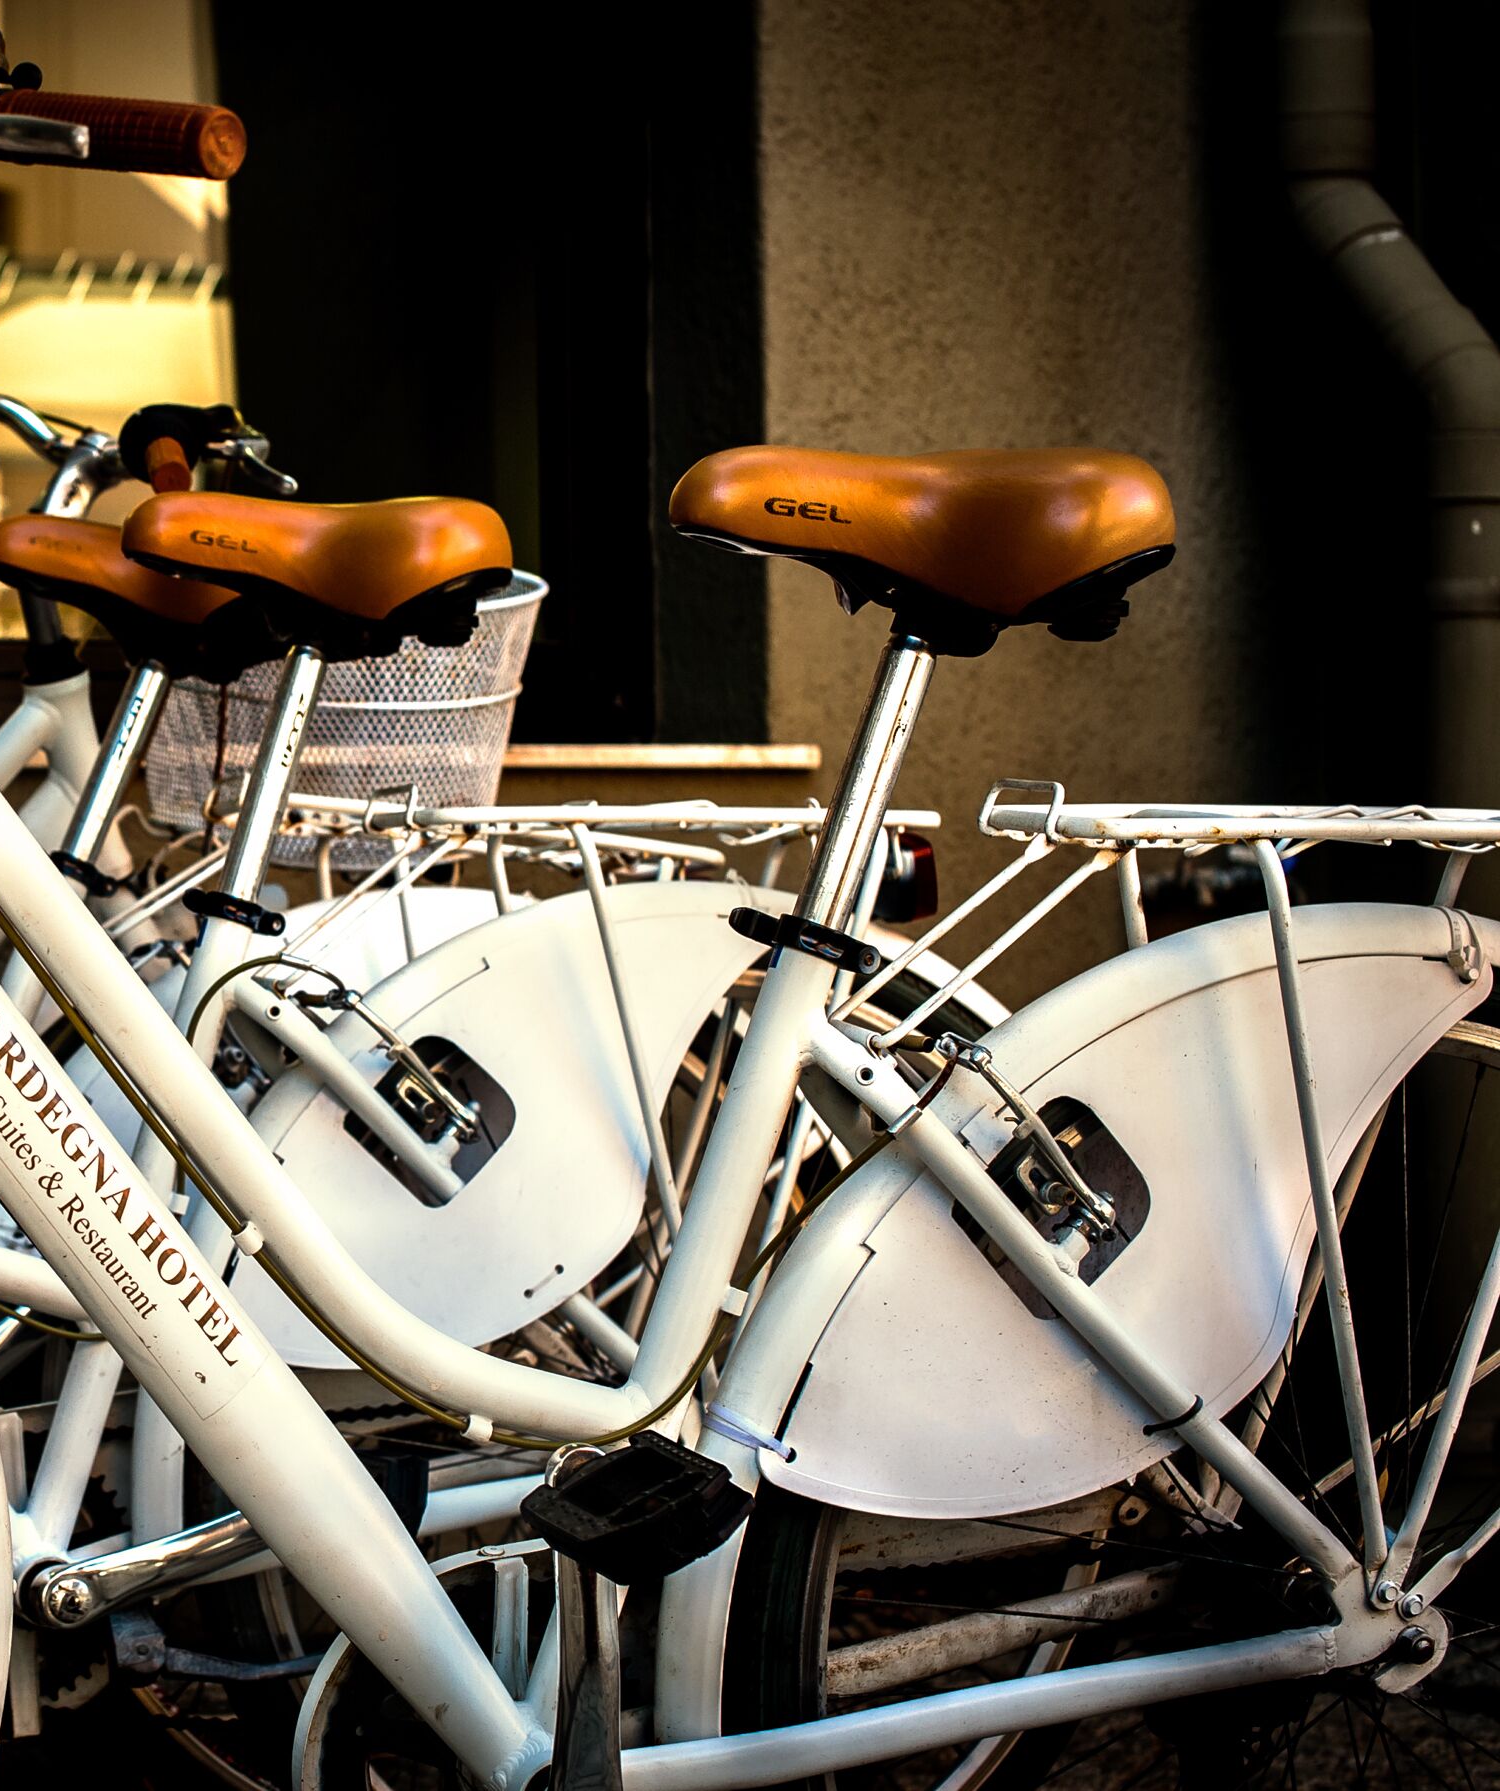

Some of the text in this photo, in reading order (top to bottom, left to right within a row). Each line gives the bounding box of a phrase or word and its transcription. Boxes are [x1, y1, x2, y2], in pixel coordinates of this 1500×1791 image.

[190, 529, 258, 554] GEL
[763, 497, 852, 525] GEL
[37, 1171, 64, 1198] &
[57, 1193, 159, 1320] Restaurant
[128, 1211, 243, 1367] HOTEL
